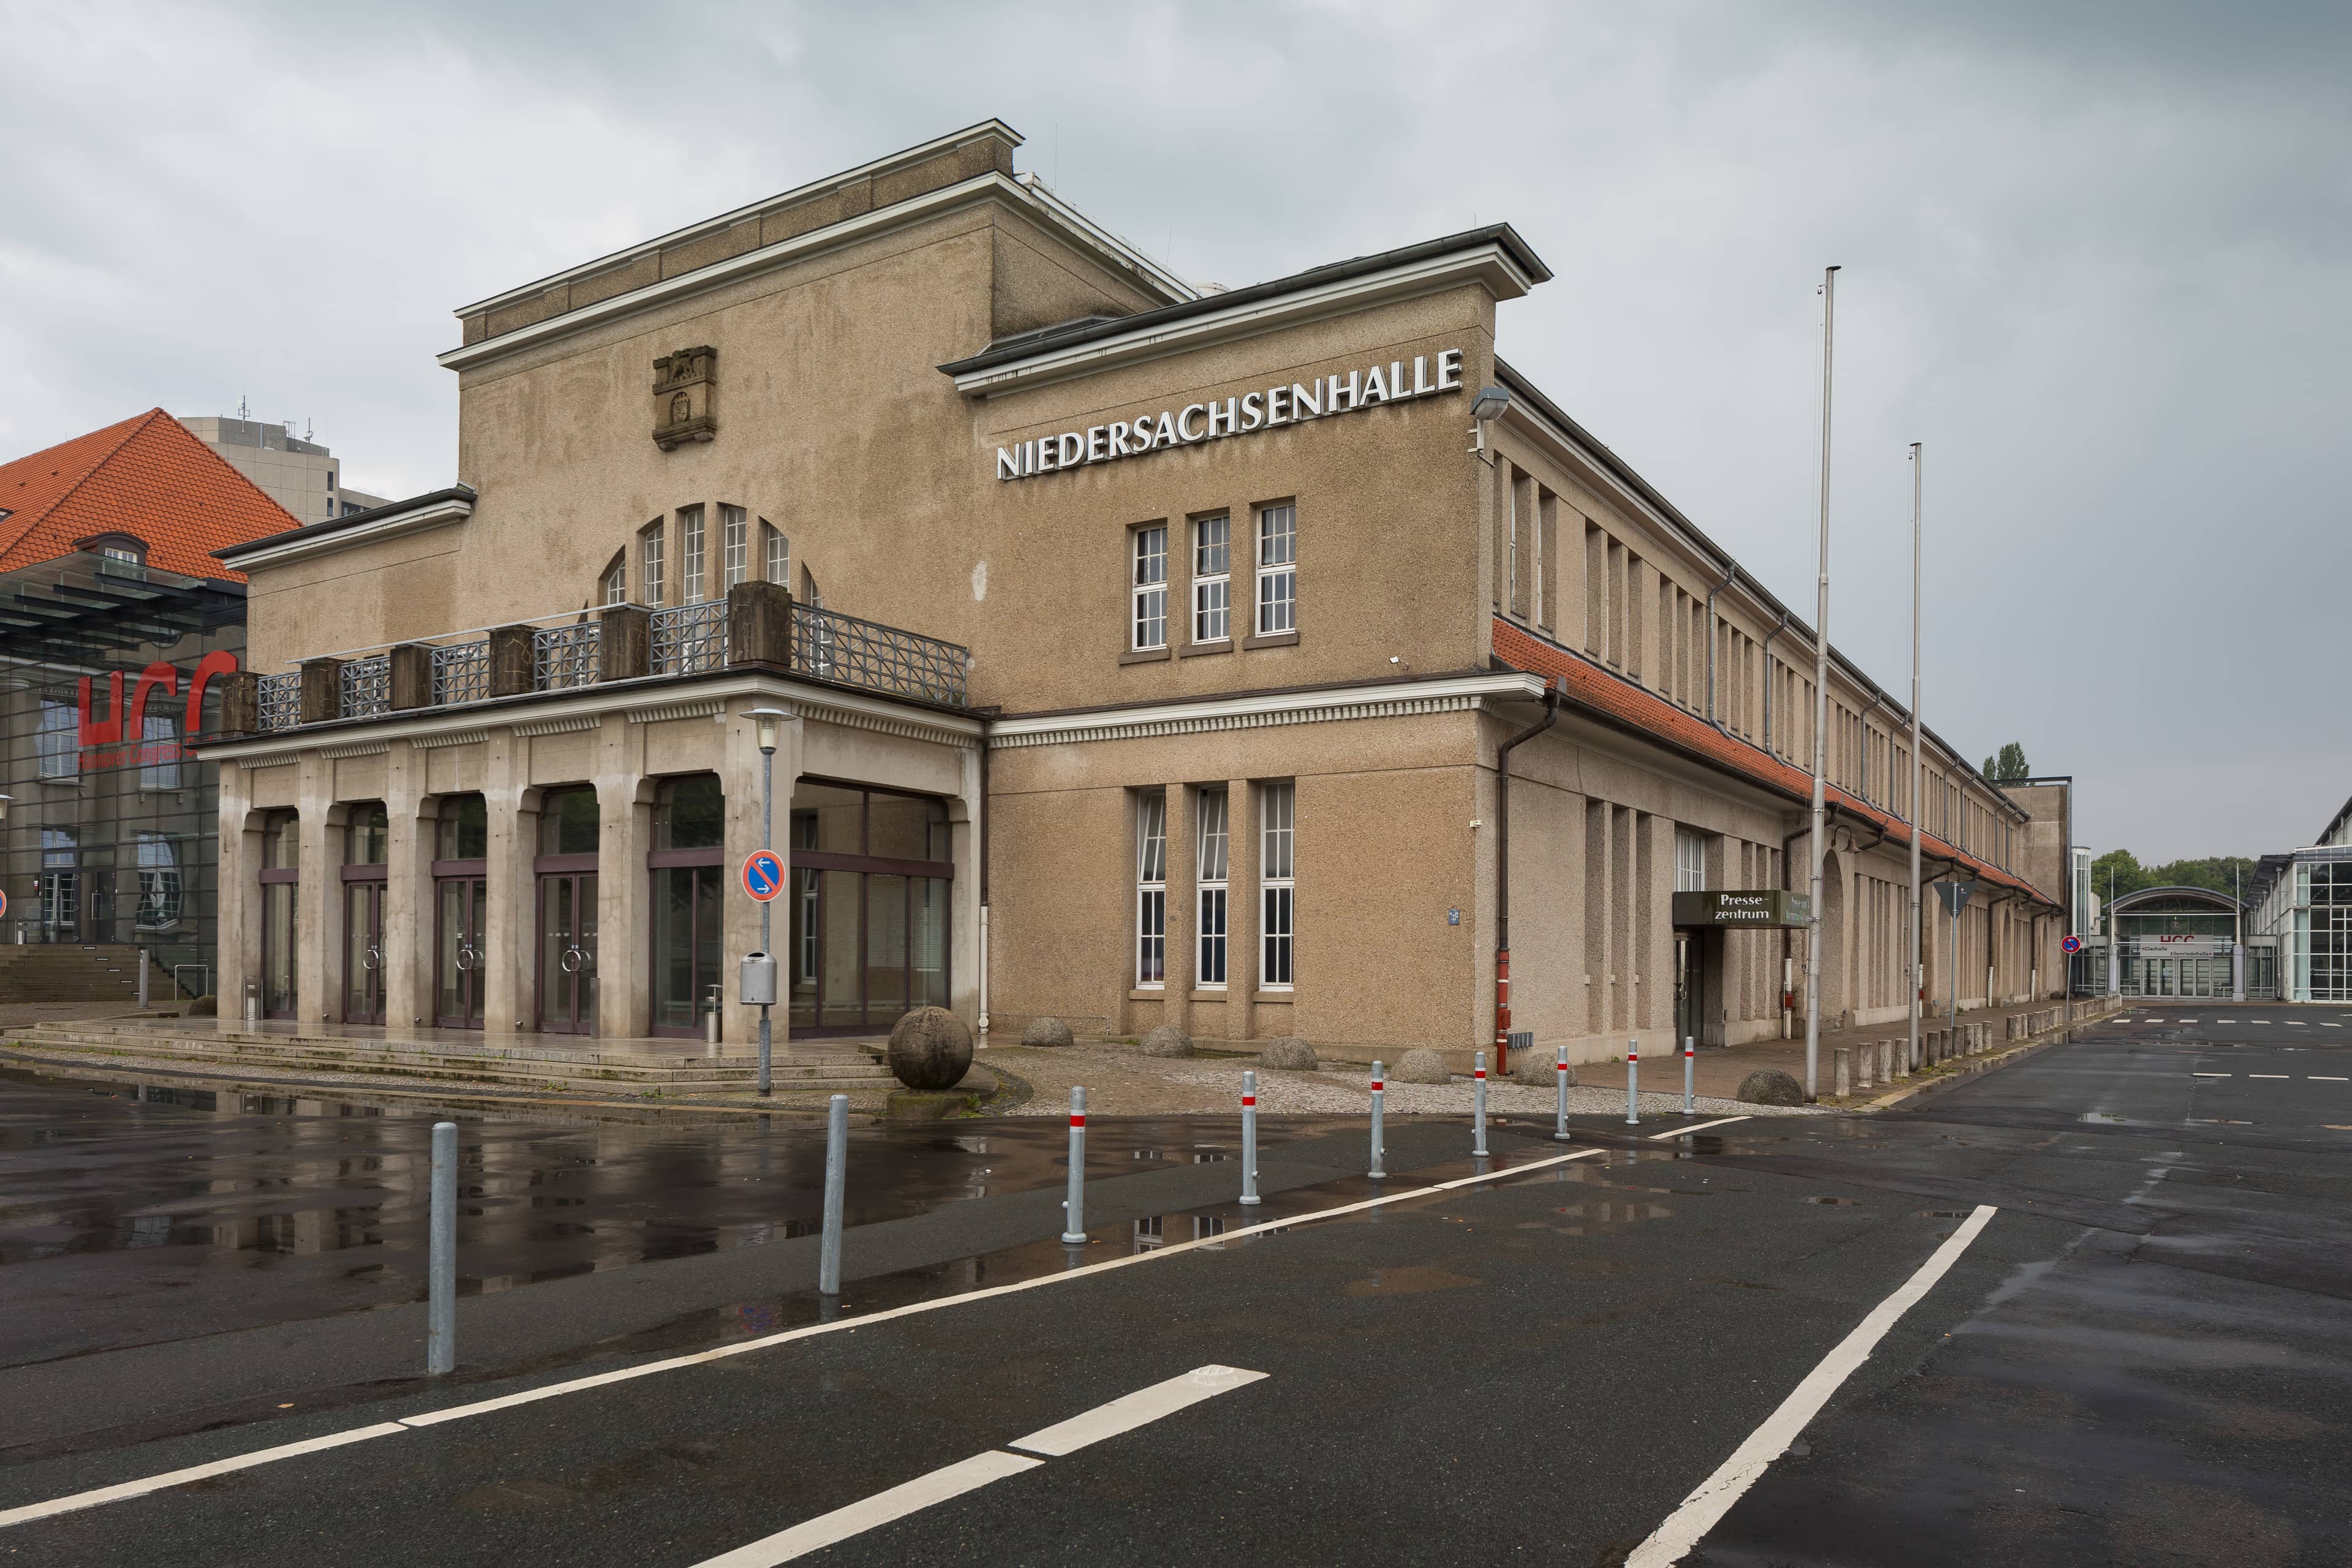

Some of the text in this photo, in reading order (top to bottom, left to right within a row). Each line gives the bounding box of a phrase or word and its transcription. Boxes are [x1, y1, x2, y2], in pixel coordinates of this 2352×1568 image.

[997, 347, 1463, 480] NIEDERSACHSENHALLE
[78, 749, 127, 771] Hannover
[130, 742, 182, 764] Congress
[1714, 909, 1770, 919] zentrum
